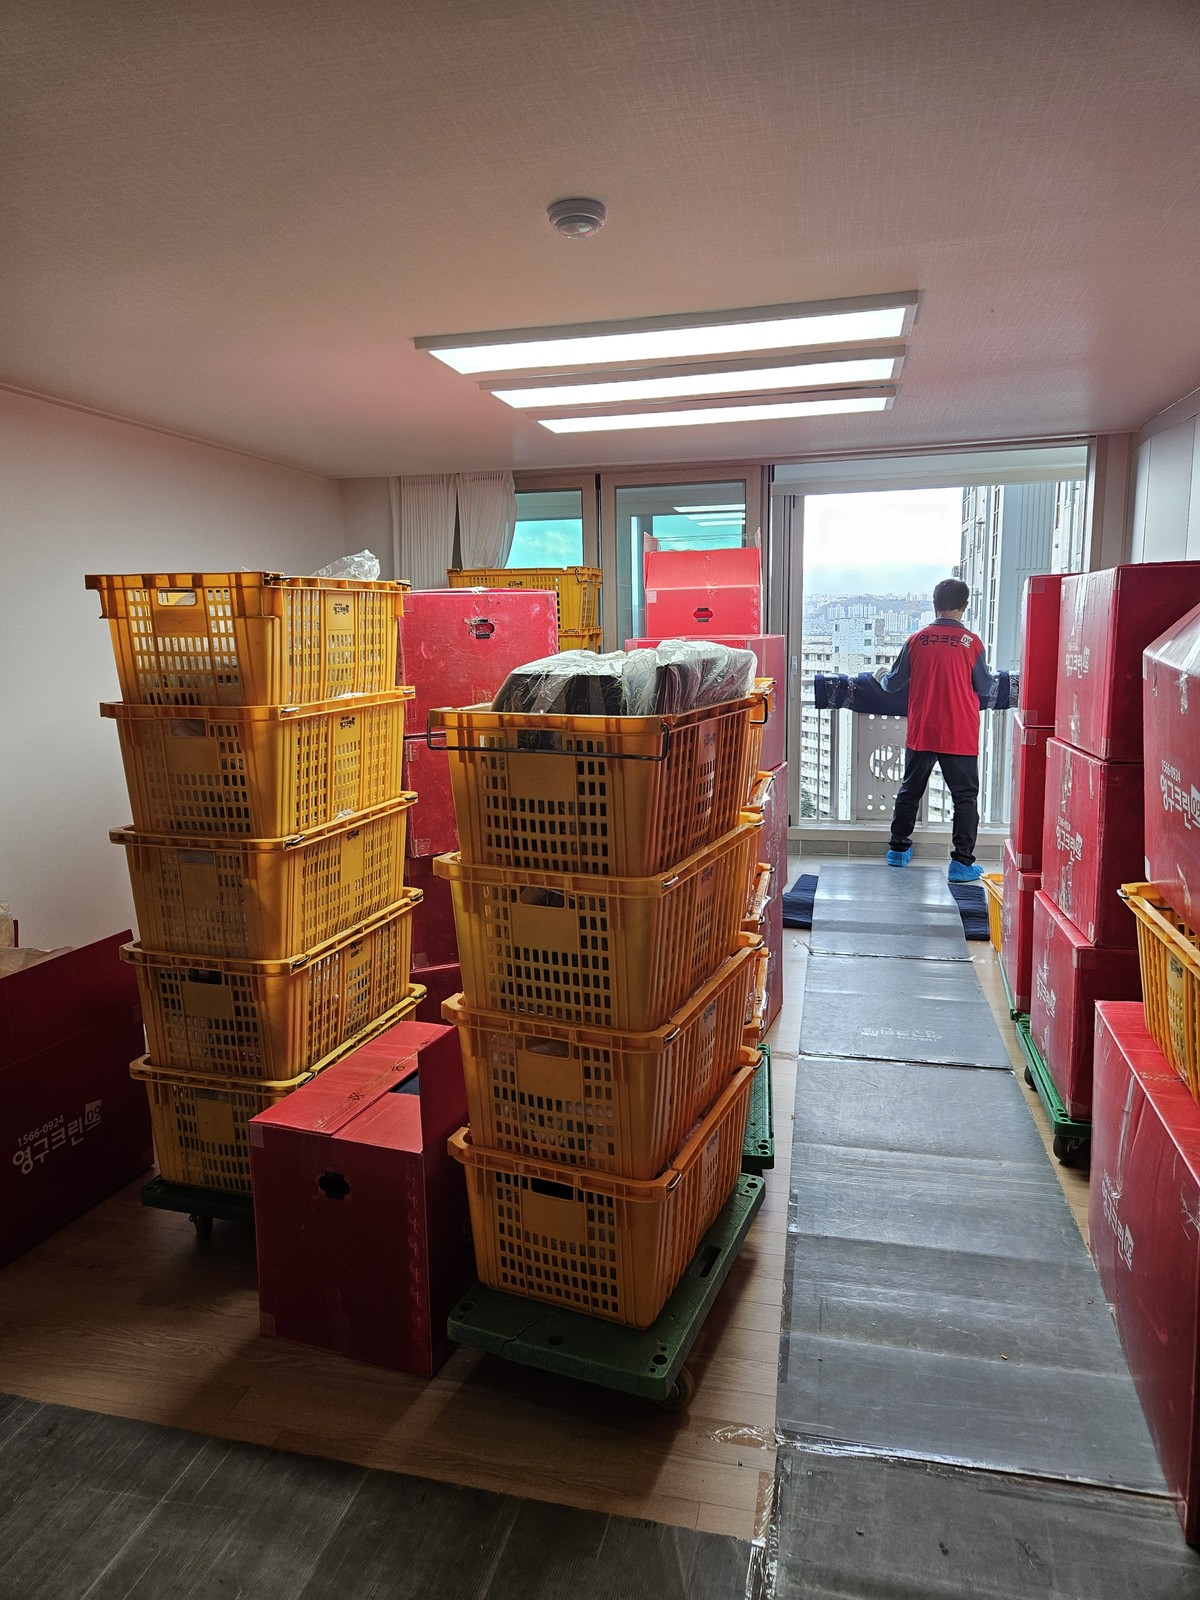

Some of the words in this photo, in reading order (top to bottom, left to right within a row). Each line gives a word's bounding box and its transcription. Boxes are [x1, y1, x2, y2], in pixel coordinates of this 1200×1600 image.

[919, 634, 960, 647] 영구크린
[1160, 773, 1192, 830] 영구크린
[1056, 825, 1075, 861] 영구크린
[12, 1116, 84, 1175] 영구크린
[17, 1114, 65, 1147] 1566-0924
[1102, 1180, 1124, 1262] 영구크린
